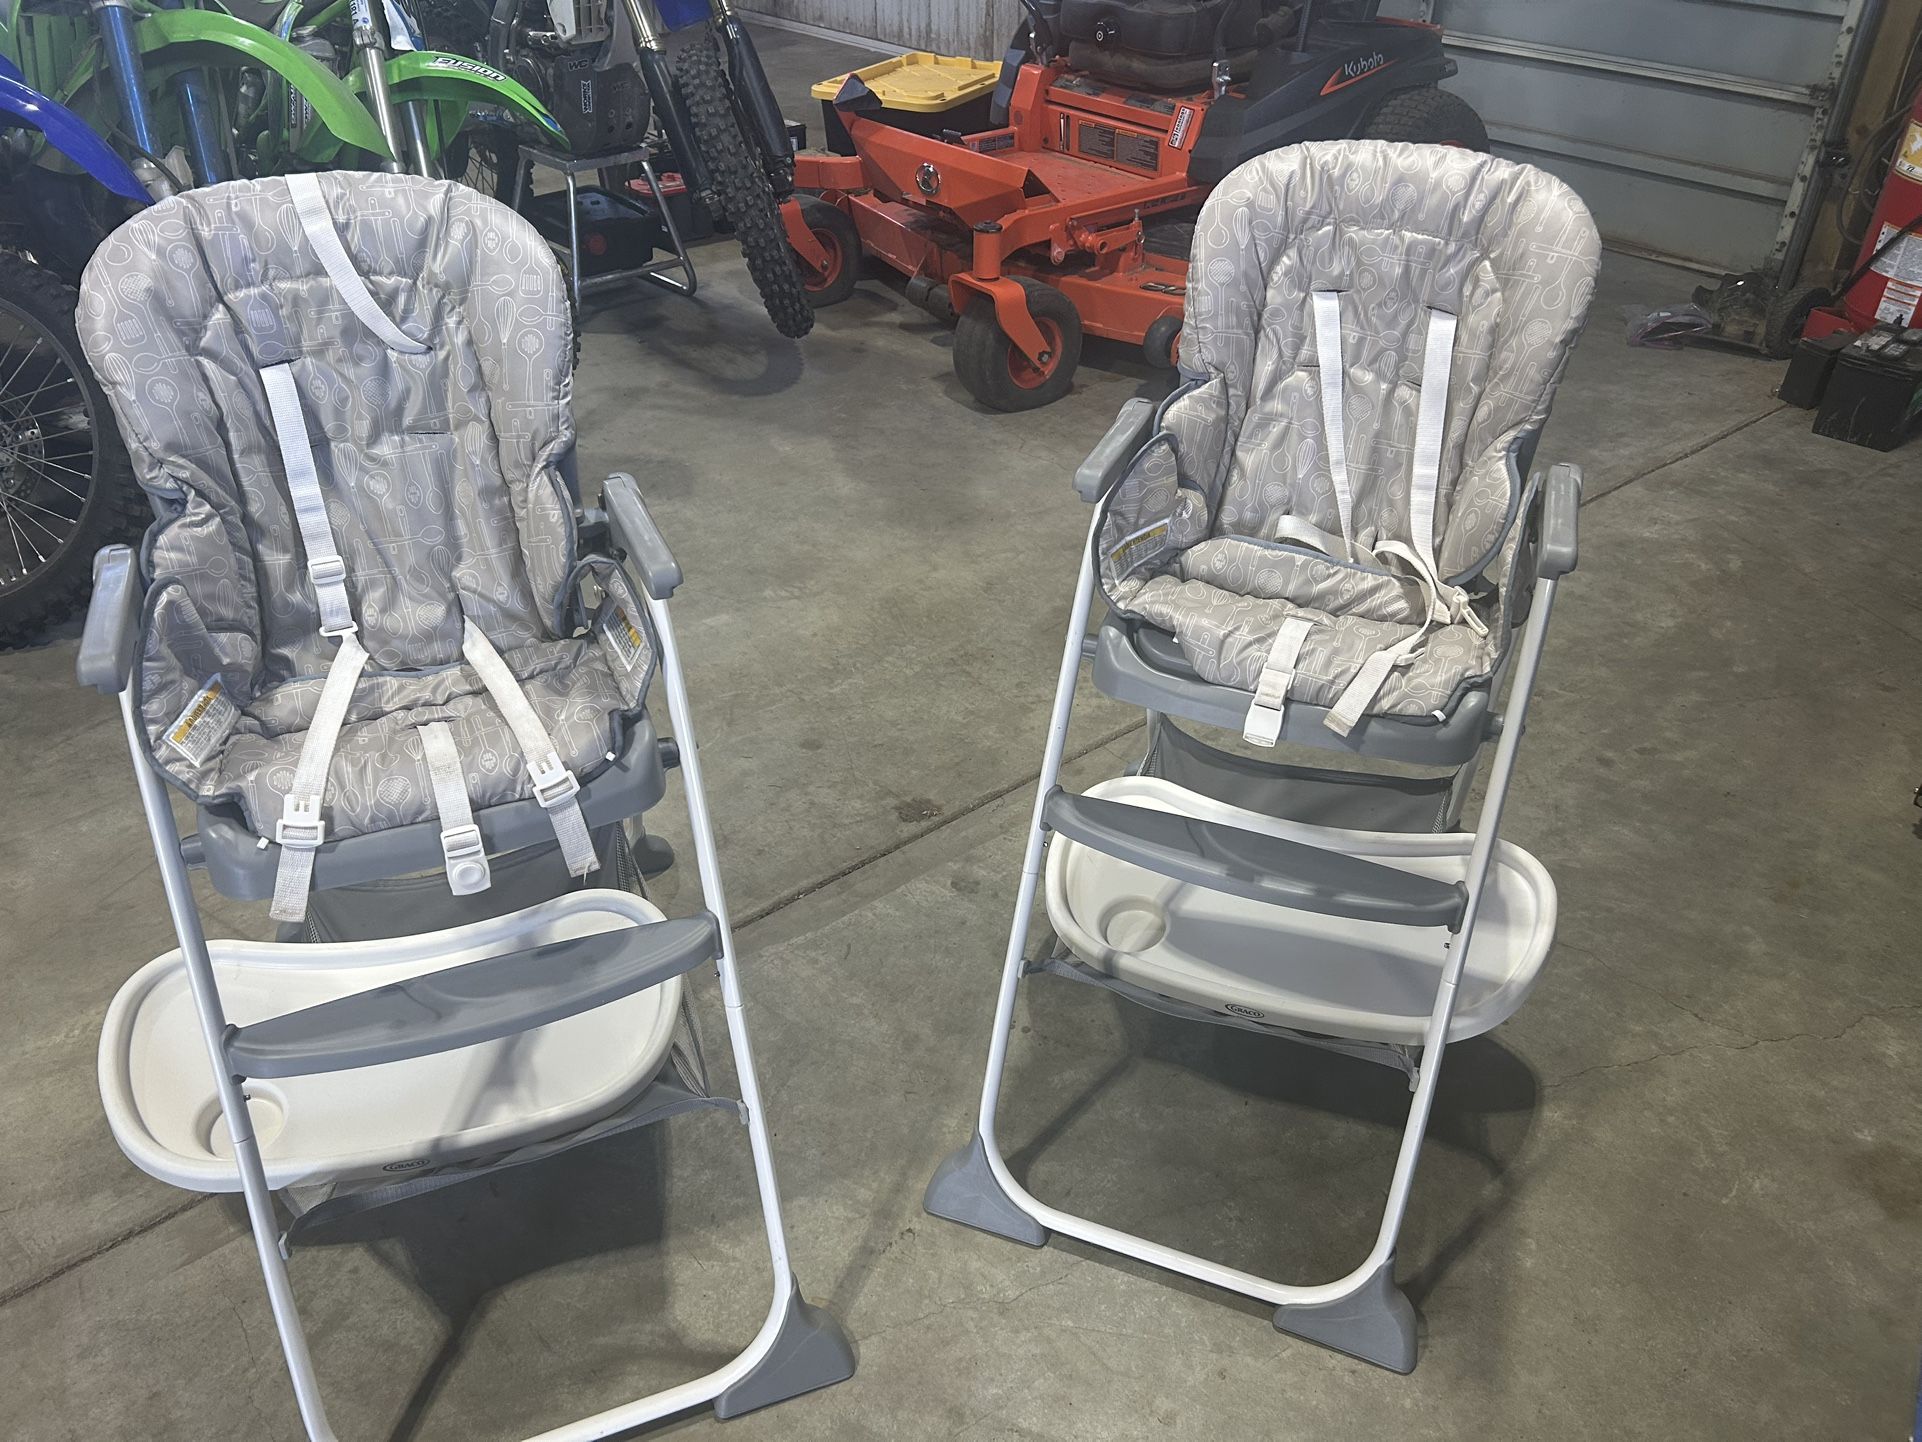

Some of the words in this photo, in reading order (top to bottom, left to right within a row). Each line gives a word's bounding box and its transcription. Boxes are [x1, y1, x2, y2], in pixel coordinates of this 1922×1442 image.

[433, 56, 507, 82] FUSION
[568, 58, 589, 71] WC
[1344, 51, 1384, 77] Kubota
[1230, 1004, 1261, 1017] GRACO
[389, 1160, 425, 1170] GRACO
